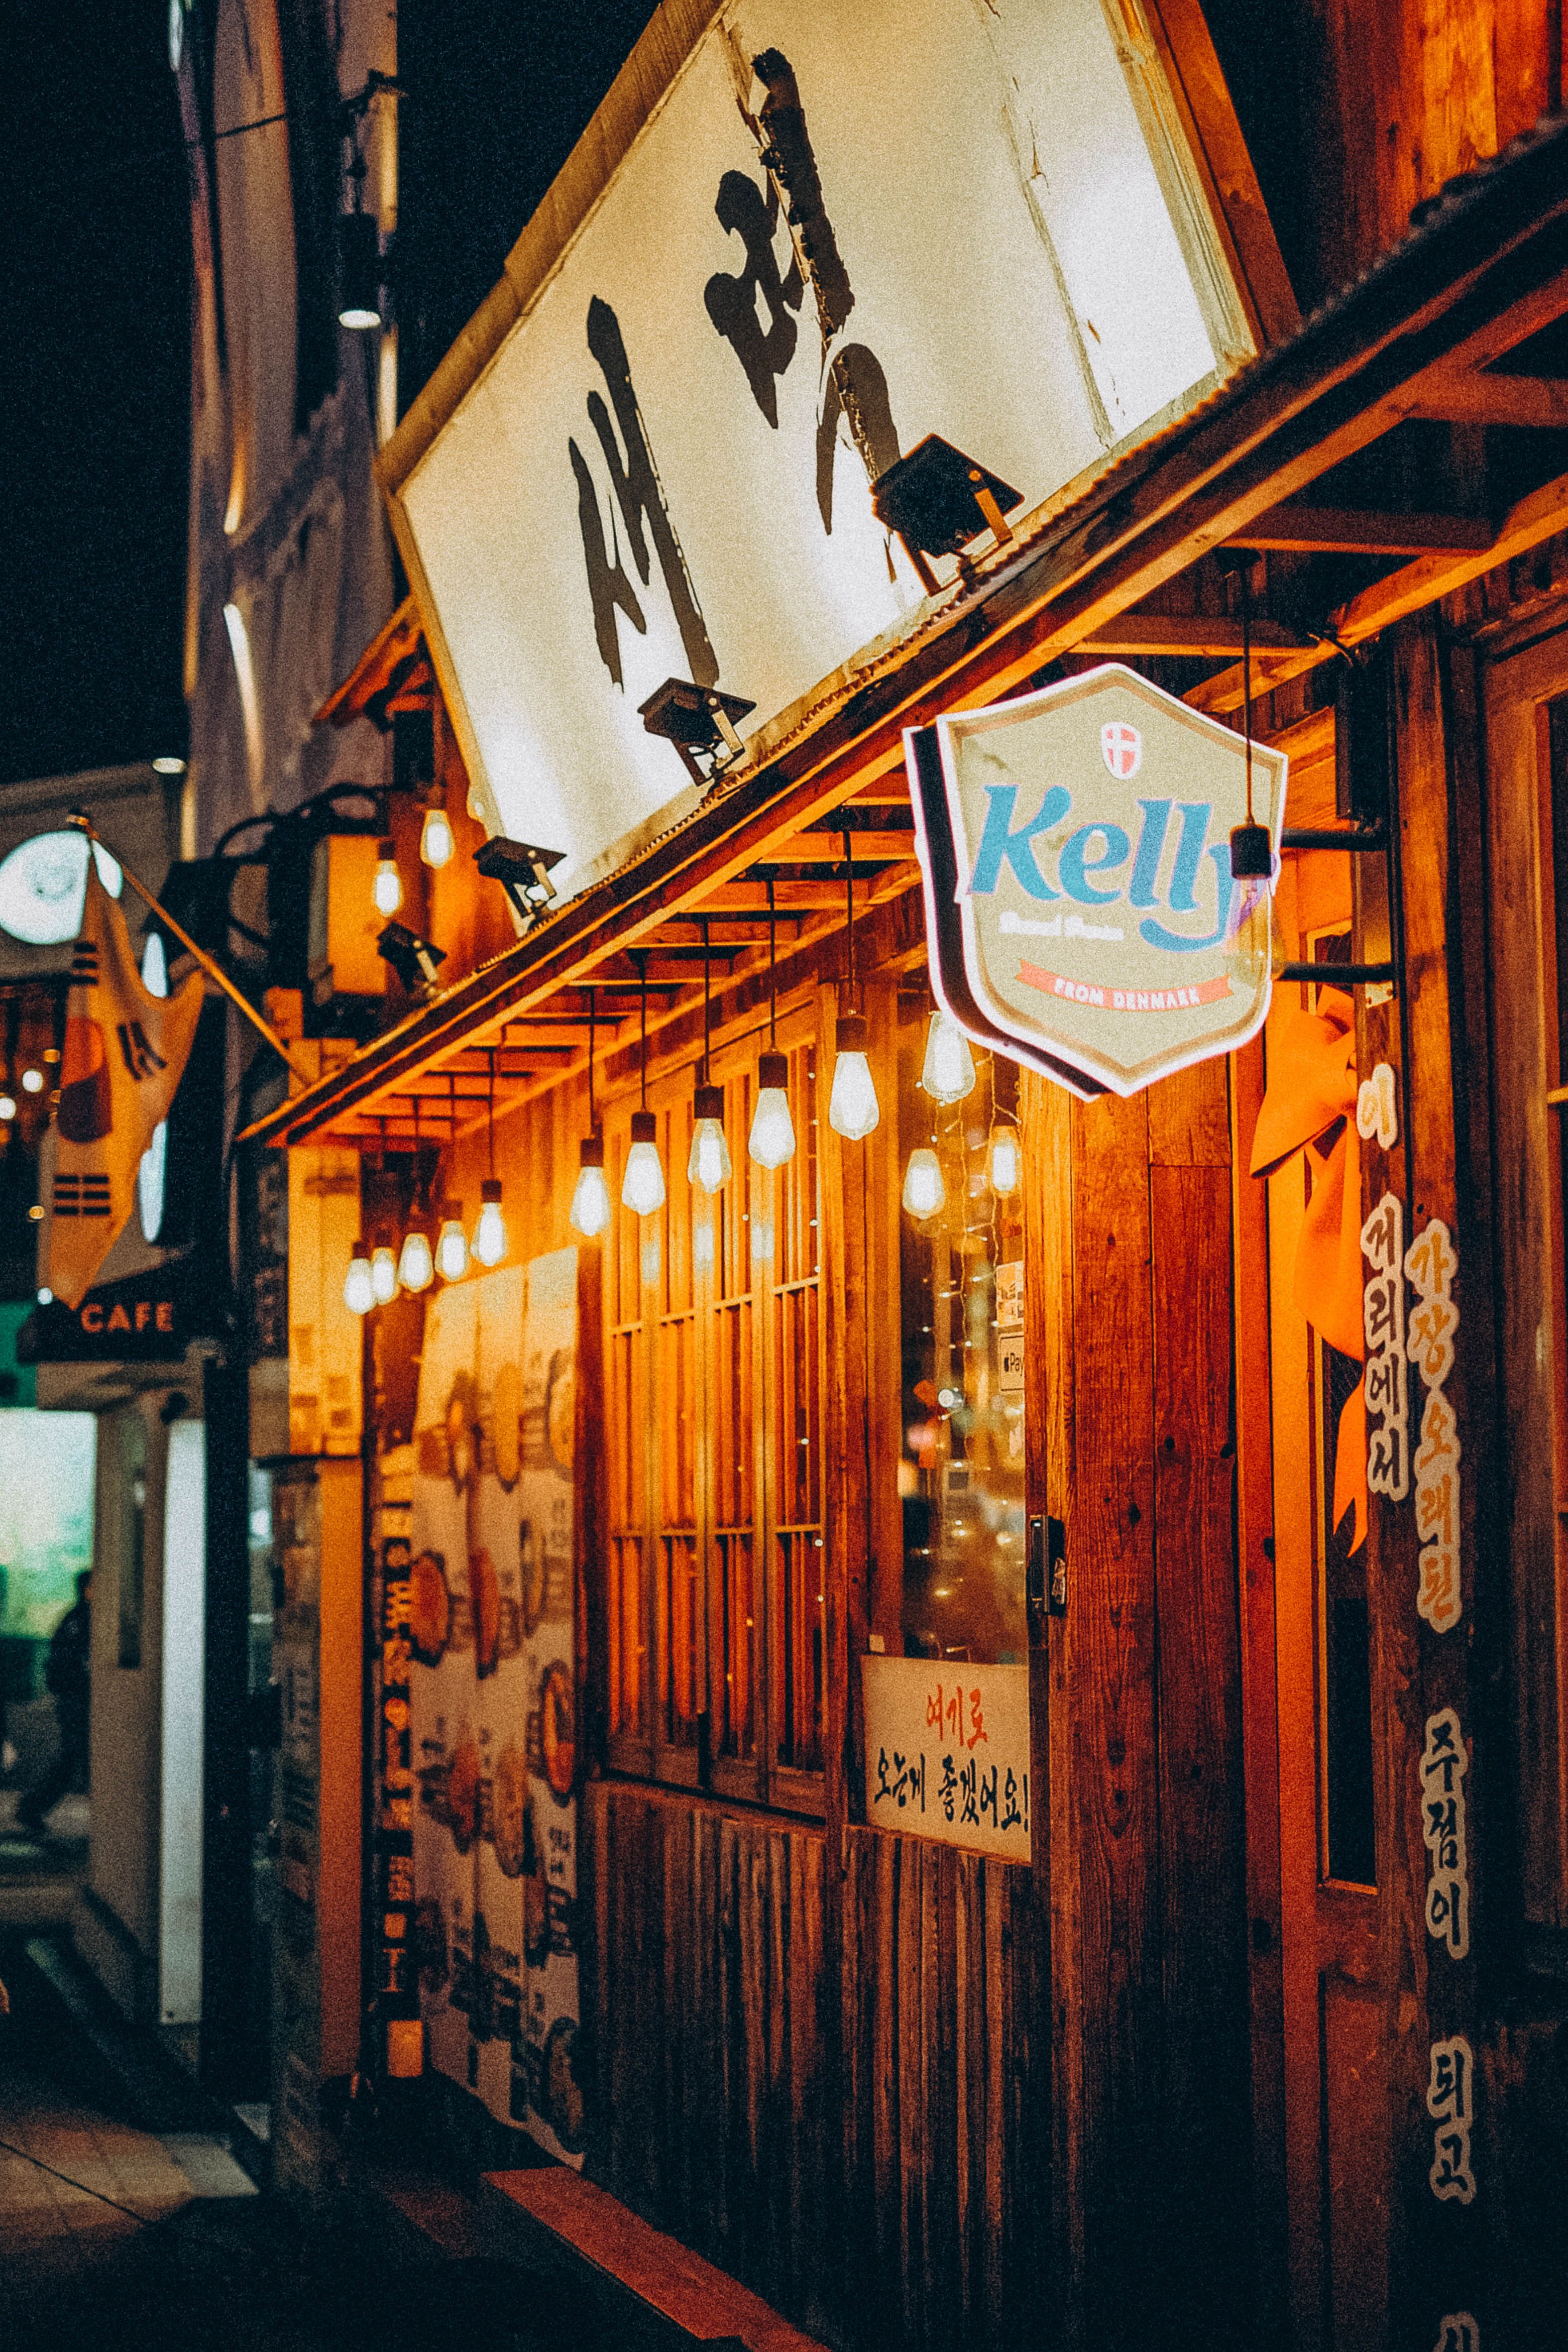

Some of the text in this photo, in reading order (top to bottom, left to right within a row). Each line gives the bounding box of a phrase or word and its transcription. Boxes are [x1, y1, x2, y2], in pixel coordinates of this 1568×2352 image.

[569, 47, 901, 694] 새벽
[966, 784, 1275, 954] Kelly
[1054, 978, 1201, 1010] FROM DENMARK
[80, 1302, 174, 1334] CAFE
[1362, 1077, 1401, 1488] 이 거리에서
[926, 1683, 988, 1751] 여기로
[875, 1747, 1029, 1832] 오는게 좋겠어요!
[1425, 1721, 1460, 1945] 주점이
[1432, 2049, 1468, 2192] 되고
